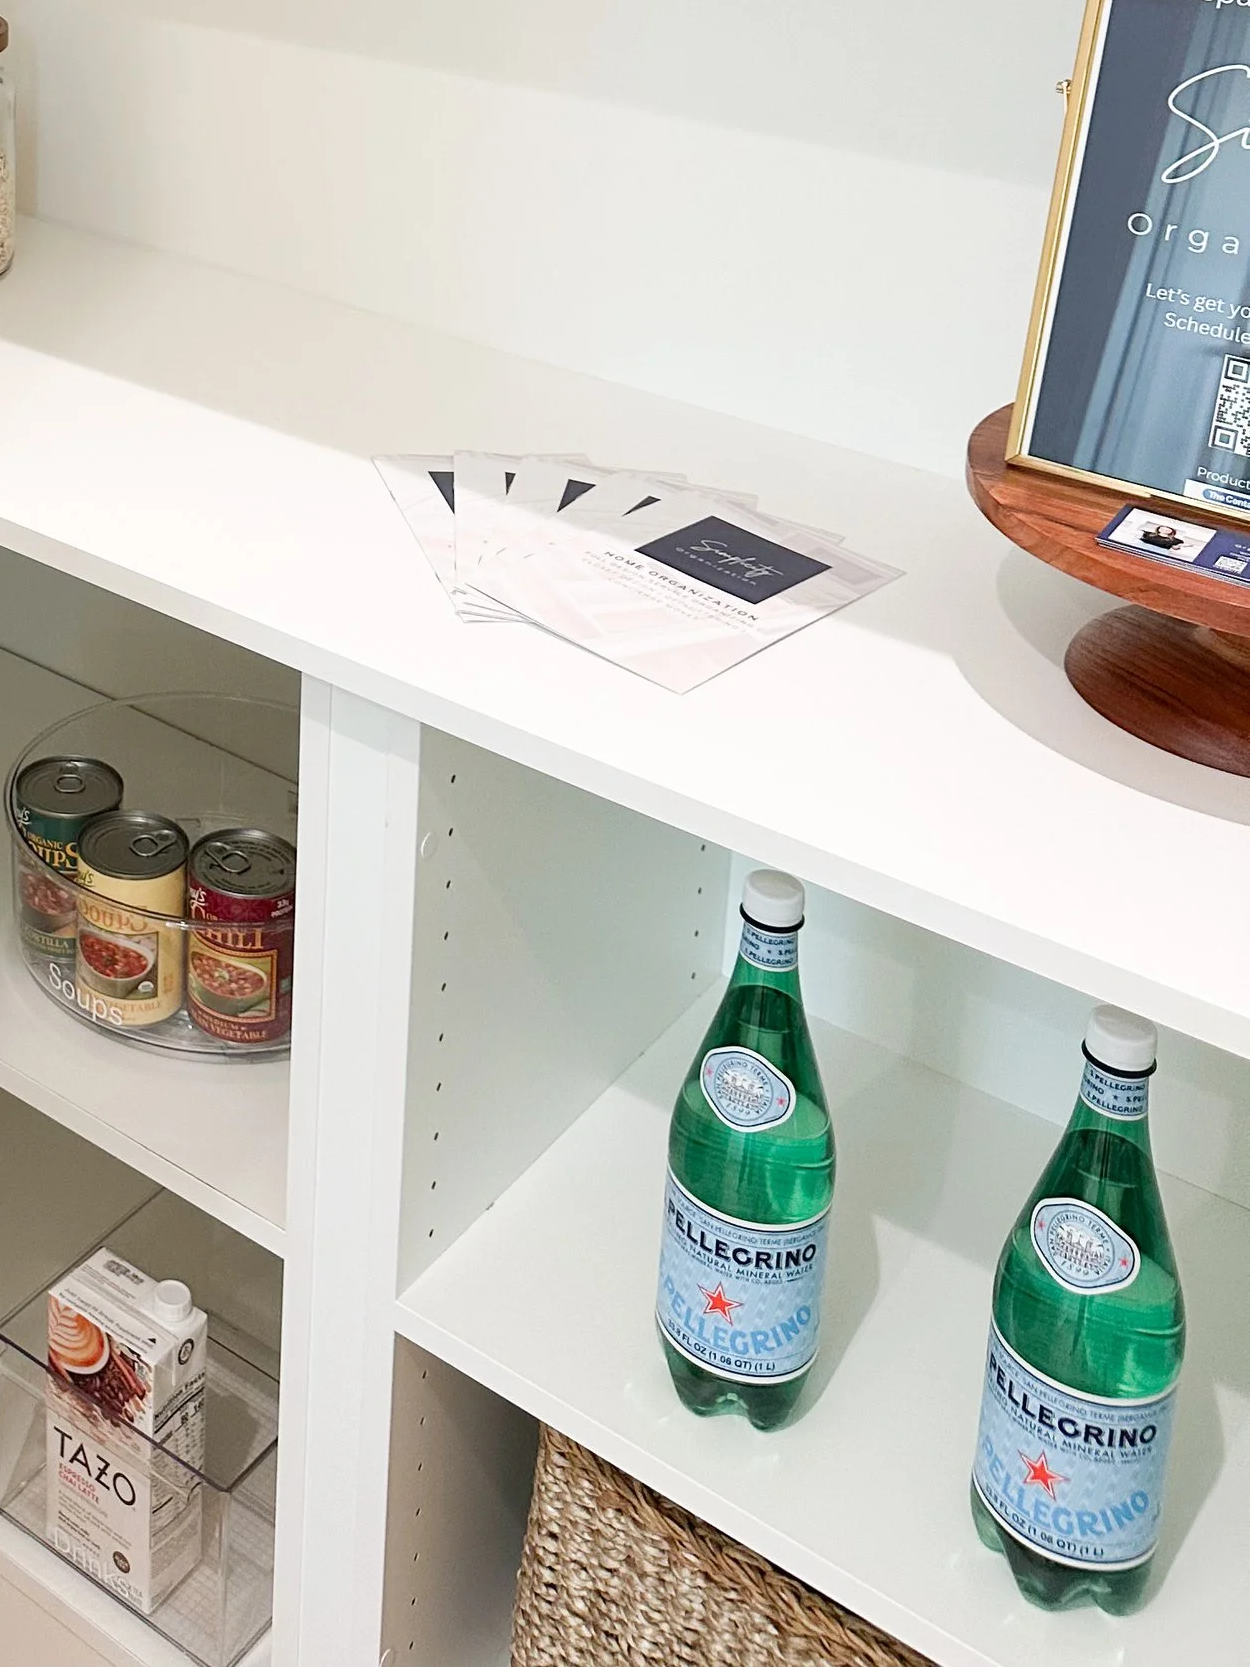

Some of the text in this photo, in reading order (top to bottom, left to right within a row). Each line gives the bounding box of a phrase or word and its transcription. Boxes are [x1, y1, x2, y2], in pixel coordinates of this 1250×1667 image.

[1127, 212, 1240, 254] Orga
[1145, 282, 1250, 320] Let's get yo
[1162, 311, 1250, 345] Schedule
[1196, 466, 1250, 490] Product
[1209, 489, 1225, 502] The
[604, 551, 759, 622] HOME ORGANIZATION
[49, 962, 123, 1026] Soups
[667, 1197, 817, 1271] PELLEGRINO
[1089, 1220, 1110, 1244] TERME
[689, 1242, 733, 1272] NATURAL
[736, 1267, 783, 1280] MINERAL
[785, 1263, 814, 1278] WATER
[662, 1274, 812, 1356] PELLEGRINO
[681, 1333, 693, 1347] FL
[693, 1341, 707, 1357] OZ
[734, 1359, 752, 1371] QT)
[754, 1362, 763, 1372] (1
[765, 1361, 776, 1372] L)
[988, 1352, 1158, 1449] PELLEGRINO
[1009, 1404, 1057, 1443] NATURAL
[1061, 1439, 1116, 1459] MINERAL
[53, 1425, 137, 1507] TAZO
[981, 1435, 1150, 1536] PELLEGRINO
[77, 1484, 100, 1505] LATTE
[999, 1500, 1011, 1517] FL
[1011, 1512, 1027, 1528] OZ
[1056, 1538, 1078, 1553] QT)
[1079, 1543, 1089, 1557] (1
